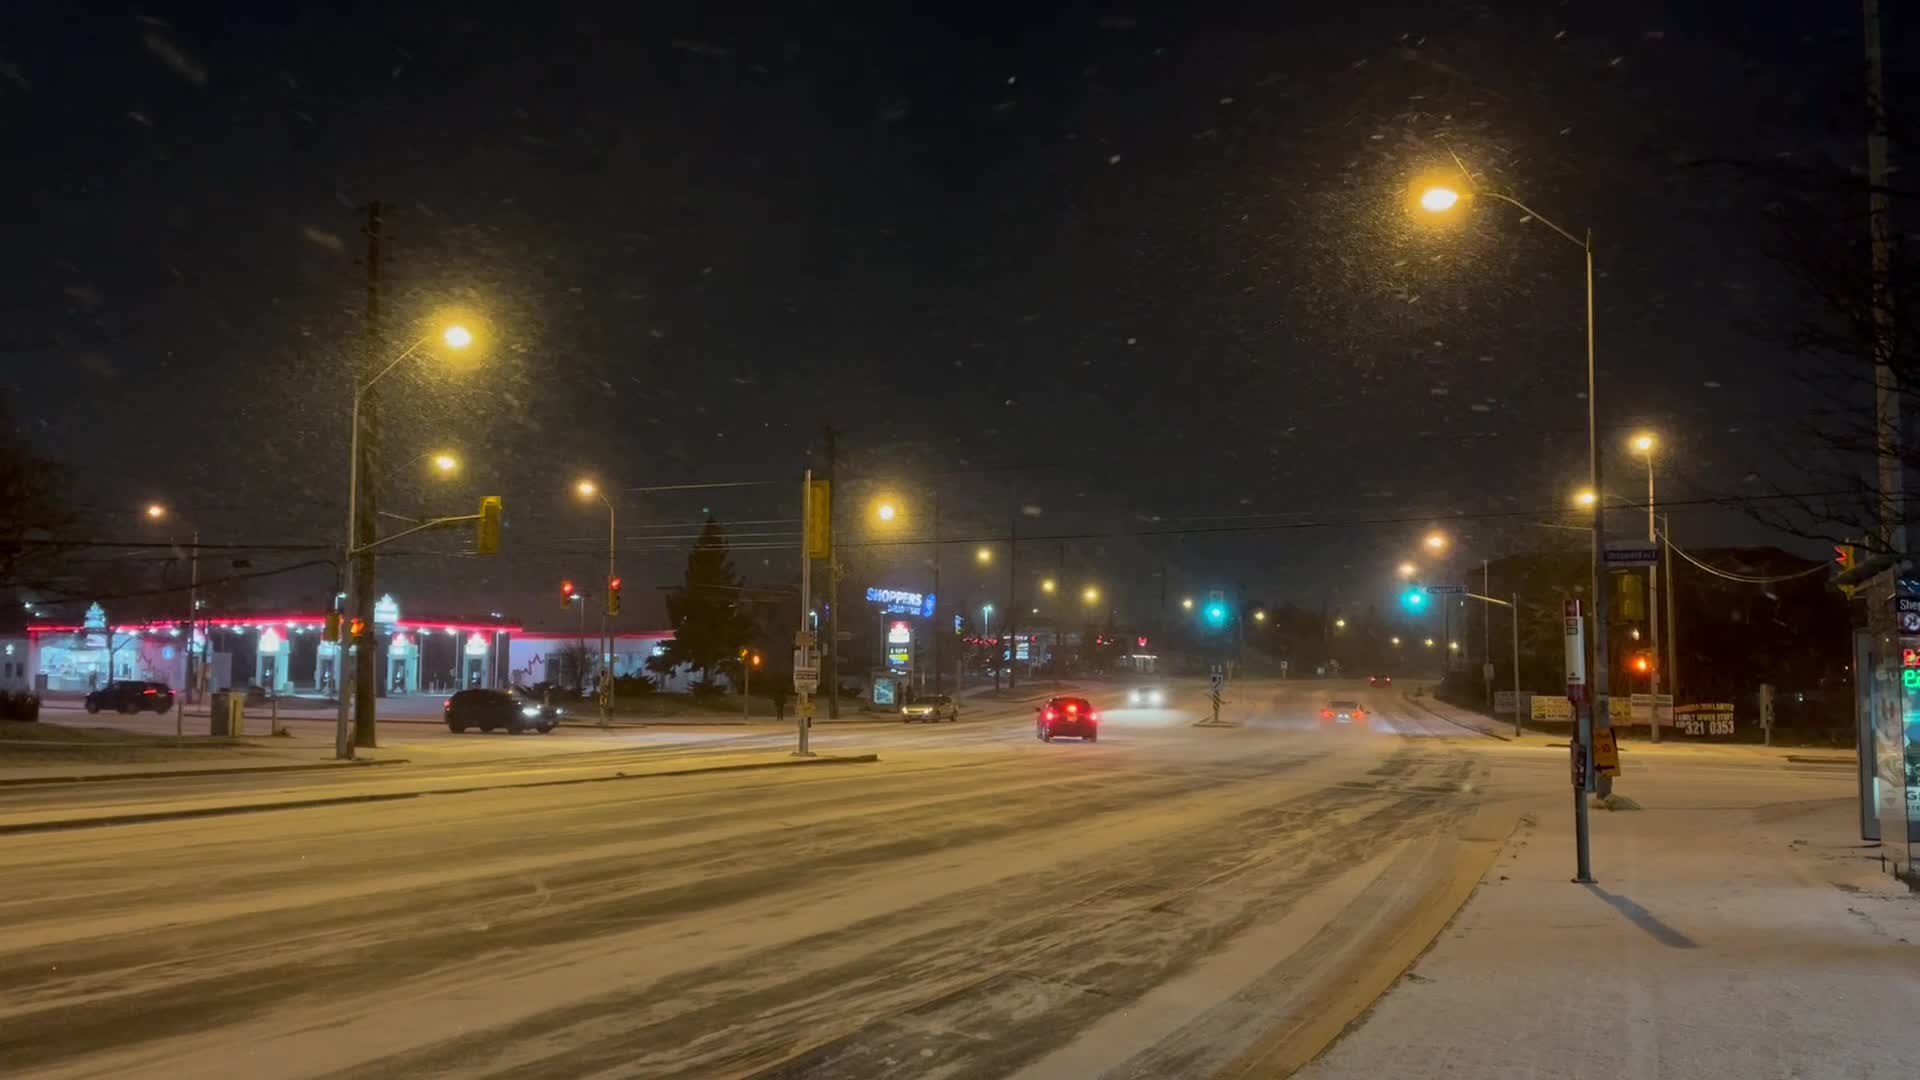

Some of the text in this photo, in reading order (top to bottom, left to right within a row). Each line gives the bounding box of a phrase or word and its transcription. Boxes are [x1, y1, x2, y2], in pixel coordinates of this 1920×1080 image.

[865, 587, 923, 606] SHOPPERS
[1685, 720, 1704, 735] 321
[1709, 720, 1734, 735] 0353
